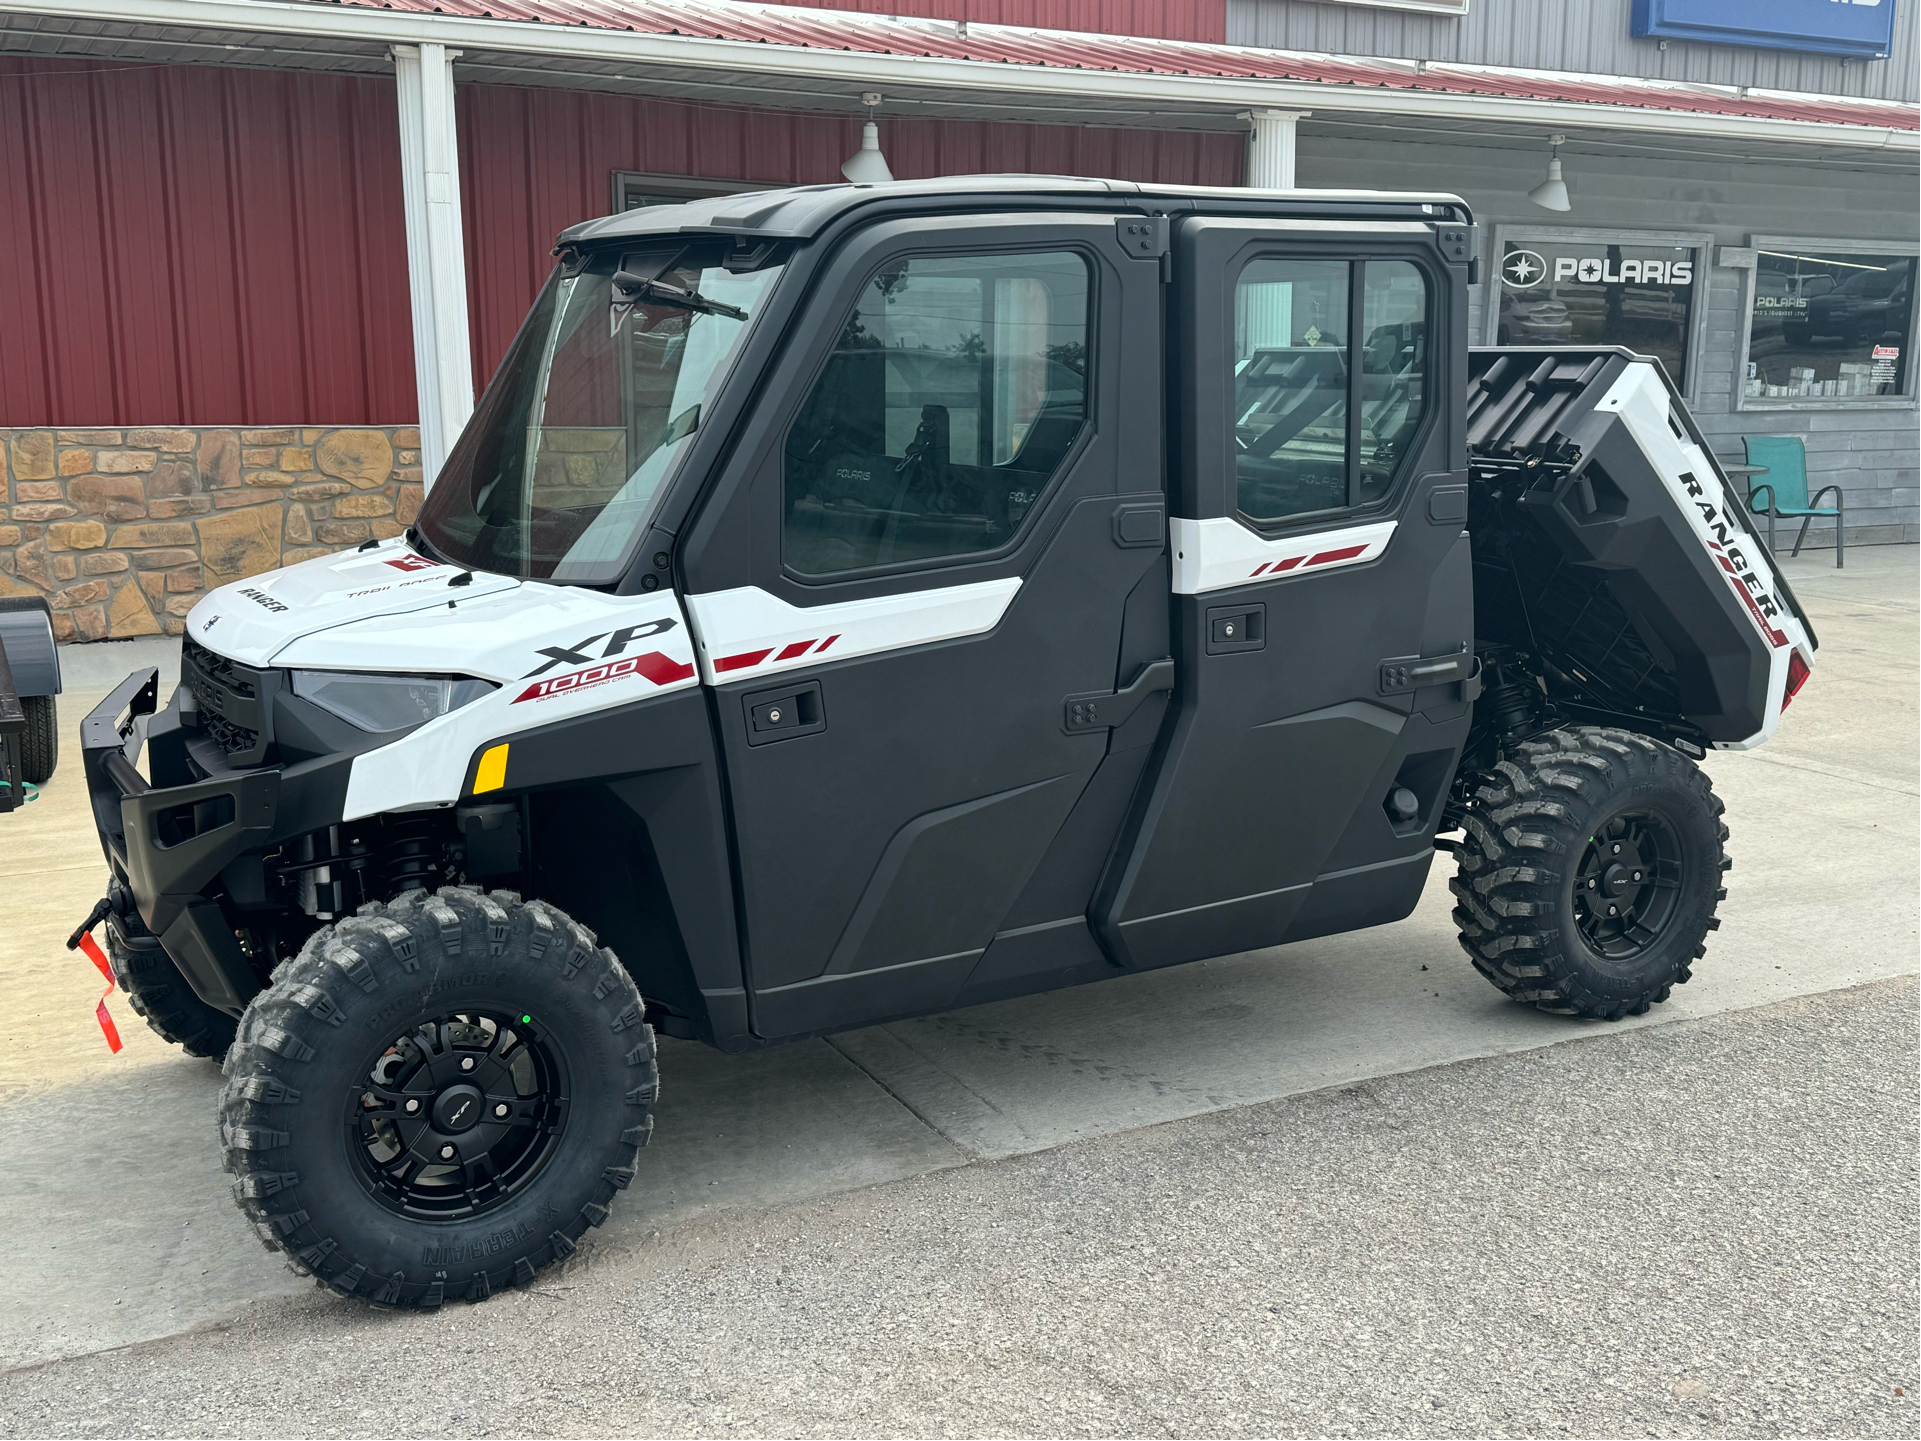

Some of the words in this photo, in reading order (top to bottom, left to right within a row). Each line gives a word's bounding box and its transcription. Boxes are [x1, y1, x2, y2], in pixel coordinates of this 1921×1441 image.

[1554, 257, 1693, 286] POLARIS
[1756, 296, 1807, 308] POLARIS
[836, 468, 871, 481] POLARIS
[1678, 471, 1778, 620] RANGER
[236, 588, 289, 613] RANGER
[1751, 607, 1765, 627] TRAIL
[1763, 626, 1778, 646] BOSS
[517, 617, 679, 681] XP
[535, 693, 561, 703] DUAL
[562, 679, 610, 697] OVERHEAD
[611, 674, 632, 683] CAM
[538, 658, 638, 696] 1000
[365, 995, 408, 1030] PRO
[412, 972, 490, 1003] ARMOR
[450, 1100, 471, 1125] XP
[422, 1199, 562, 1267] X-TERRAIN
